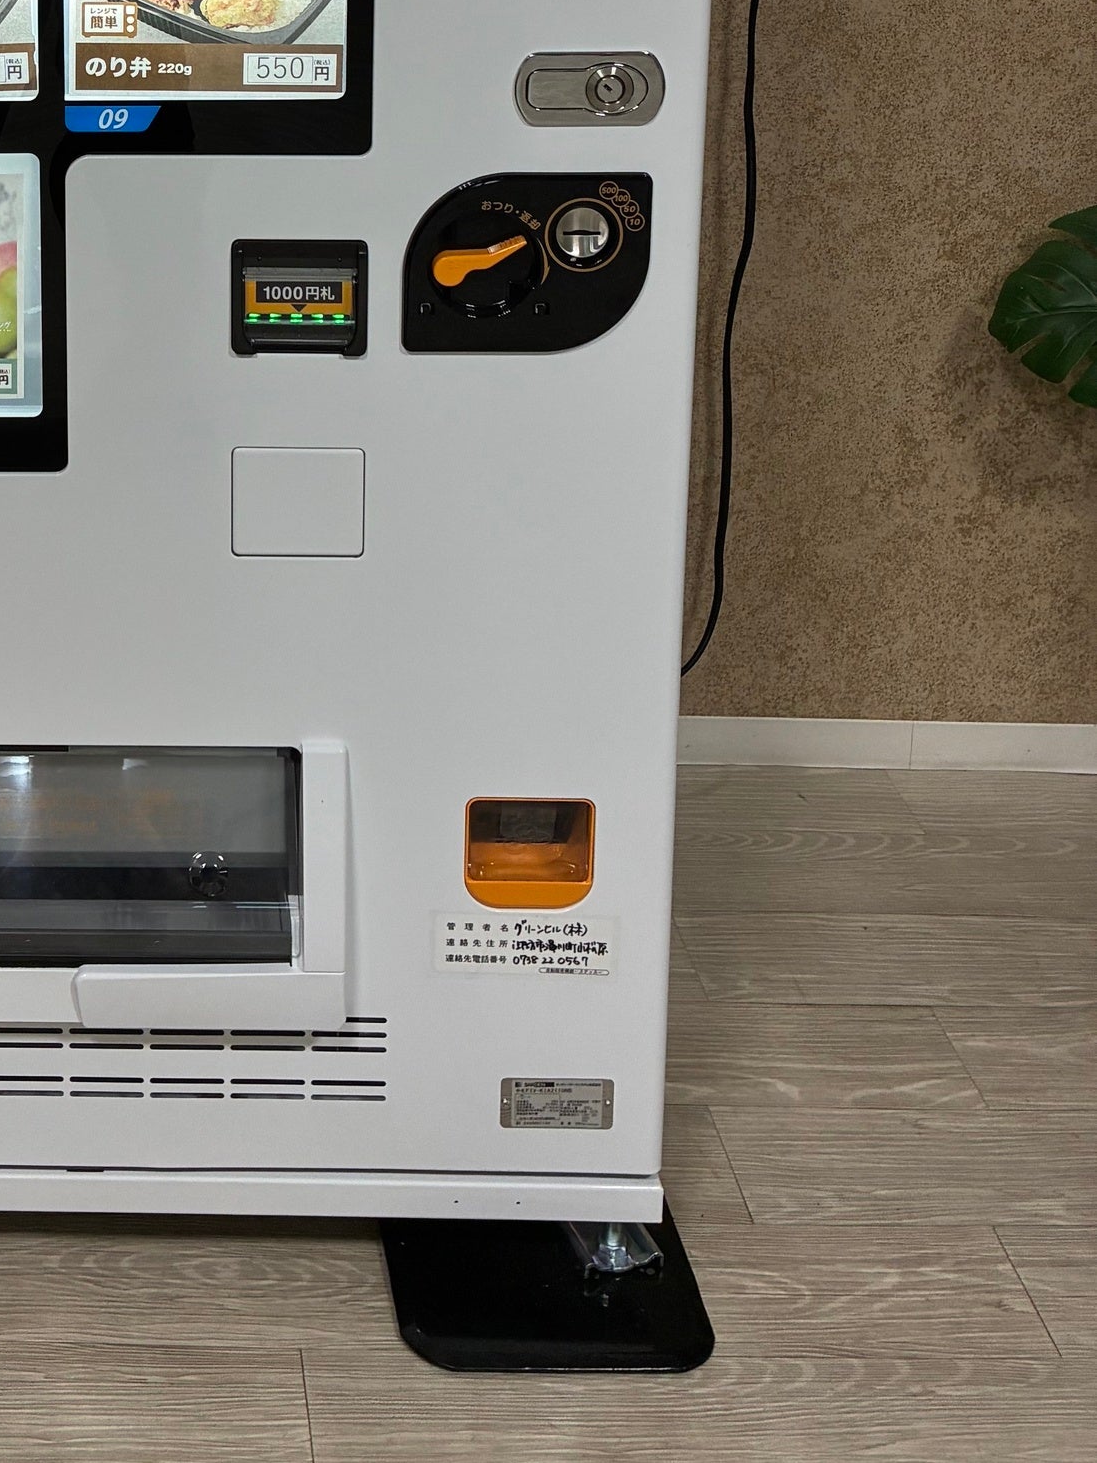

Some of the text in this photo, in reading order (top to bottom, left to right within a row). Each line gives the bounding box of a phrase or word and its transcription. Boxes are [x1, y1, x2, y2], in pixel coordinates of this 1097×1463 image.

[90, 7, 117, 15] レンジで
[90, 15, 118, 29] 簡単
[7, 65, 22, 79] 円
[85, 57, 193, 77] のり弁 220g
[256, 57, 304, 79] 550
[314, 66, 330, 81] 円
[98, 109, 129, 129] 09
[614, 194, 628, 202] 100
[263, 286, 335, 300] 1000円札
[446, 939, 508, 948] 連絡先住所
[445, 954, 507, 964] 連絡先電話番号
[513, 955, 539, 966] 0738
[557, 956, 589, 967] 0567
